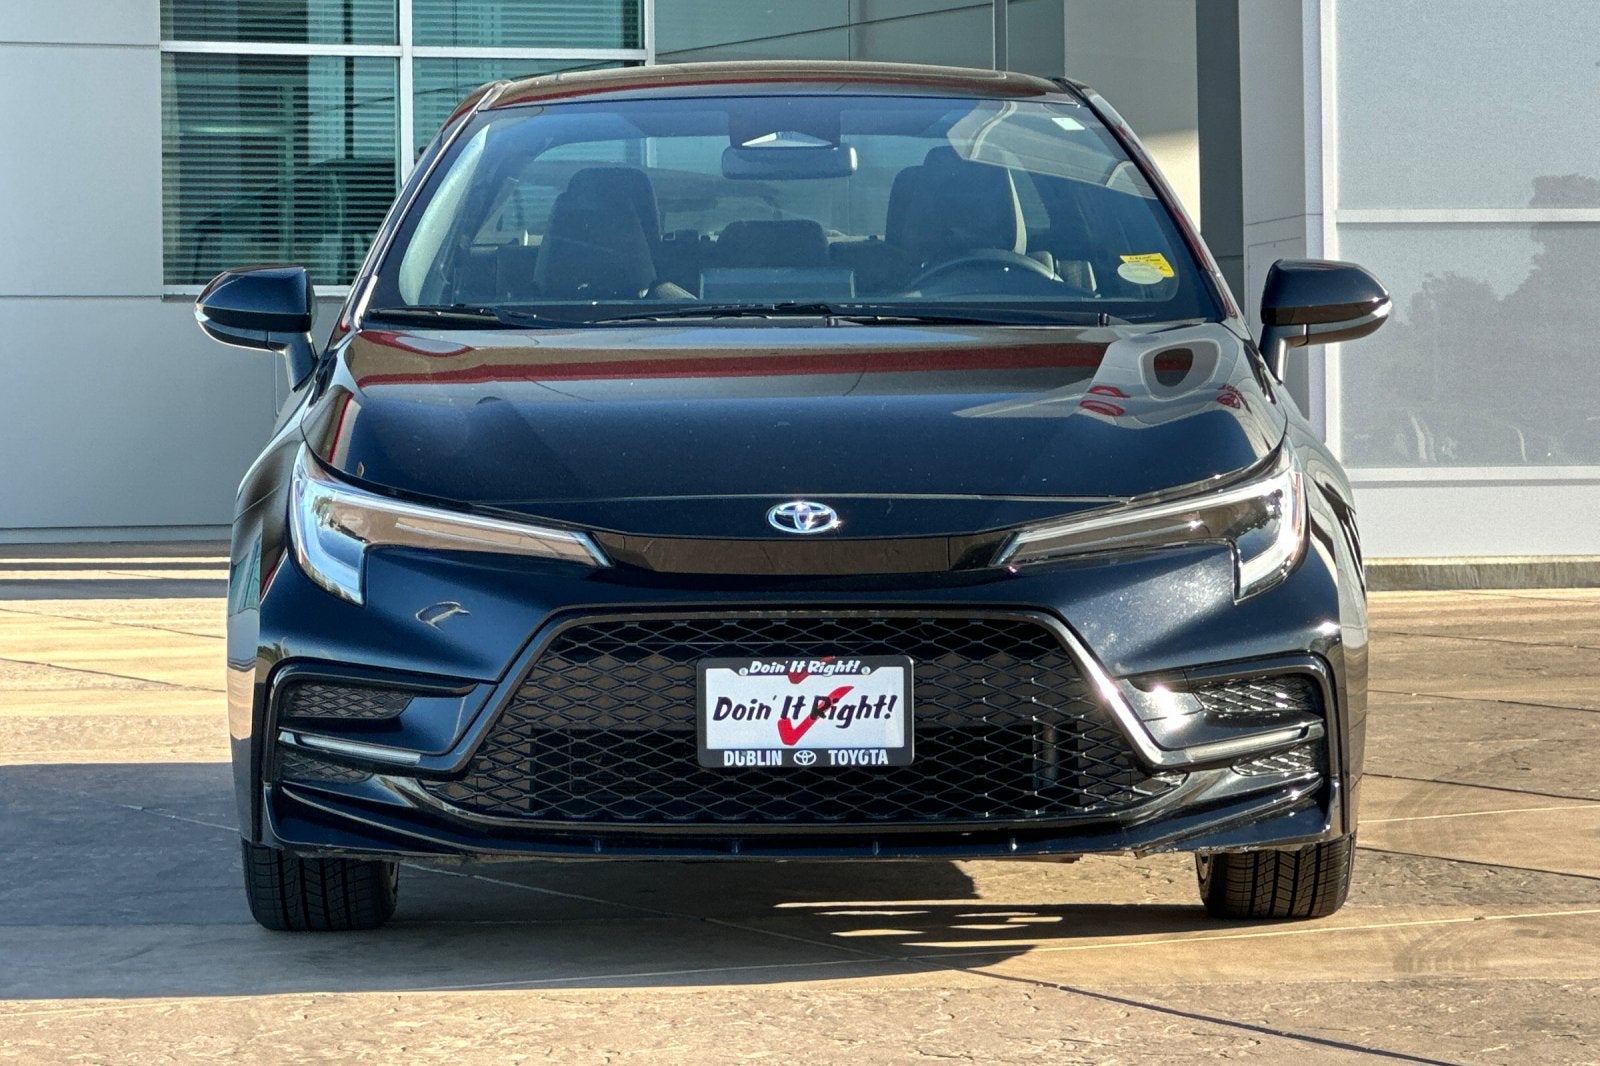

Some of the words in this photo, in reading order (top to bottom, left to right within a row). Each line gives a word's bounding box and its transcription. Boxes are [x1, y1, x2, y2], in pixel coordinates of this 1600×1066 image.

[749, 660, 788, 674] Doin'
[790, 660, 806, 674] It
[808, 660, 861, 677] Right!
[713, 695, 777, 721] Doin'
[780, 695, 806, 720] It
[810, 695, 898, 730] Right!
[723, 750, 783, 767] DUBLIN
[828, 749, 889, 766] TOYOTA
